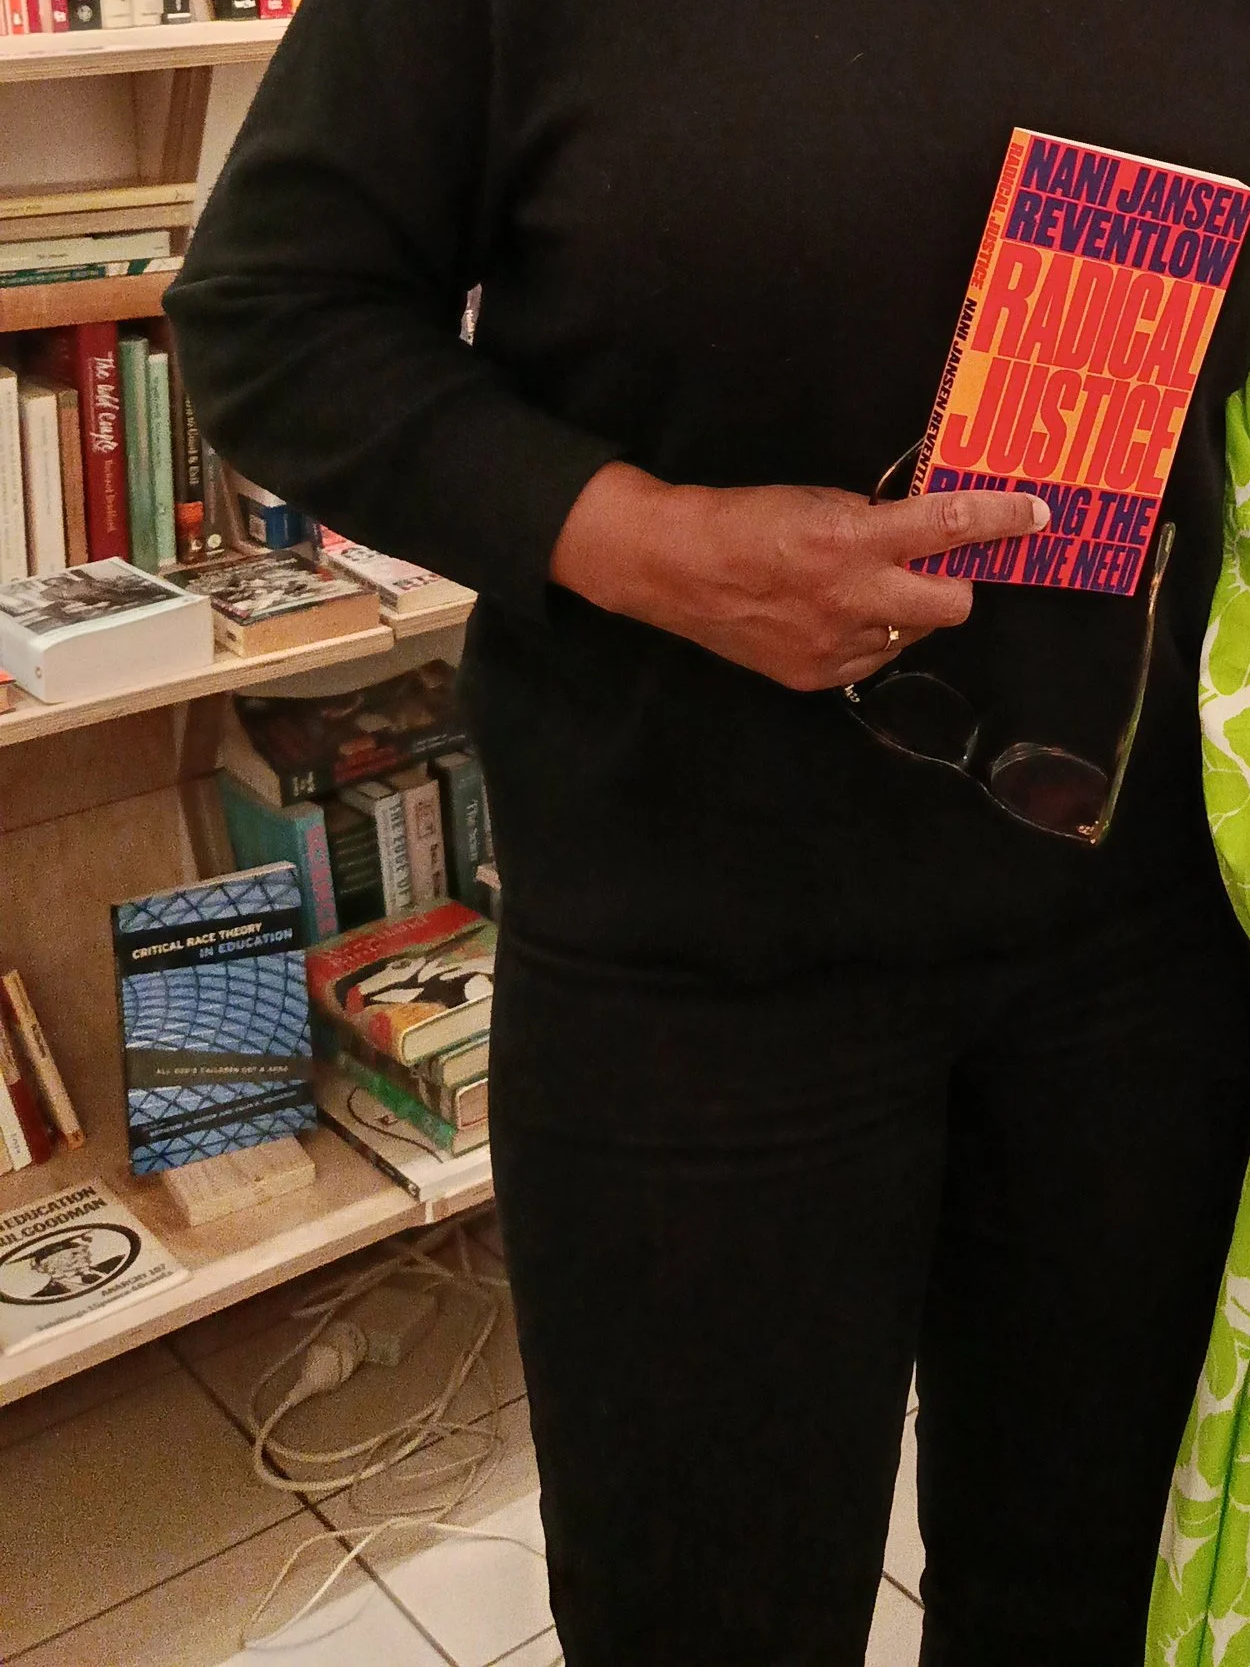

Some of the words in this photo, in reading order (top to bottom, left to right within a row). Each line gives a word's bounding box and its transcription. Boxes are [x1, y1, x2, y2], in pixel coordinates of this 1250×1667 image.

[994, 141, 1025, 217] RADICAL
[1022, 138, 1121, 202] NANI
[969, 217, 1003, 290] JUSTICE
[1005, 191, 1238, 287] REVENTLOW
[957, 296, 978, 338] NANI
[971, 242, 1216, 390] RADICAL
[94, 351, 116, 379] The
[937, 337, 966, 412] JANSEN
[909, 409, 944, 496] REVENTLO
[939, 356, 1189, 494] JUSTICE
[1092, 492, 1159, 546] THE
[1021, 534, 1075, 587] WE
[1067, 540, 1143, 596] NEED
[131, 938, 184, 961] CRITICAL
[185, 931, 217, 949] RACE
[218, 921, 263, 942] THEORY
[199, 944, 215, 960] IN
[217, 927, 293, 956] EDUCATION
[4, 1185, 98, 1231] EDUCATION
[20, 1197, 109, 1238] GOODMAN
